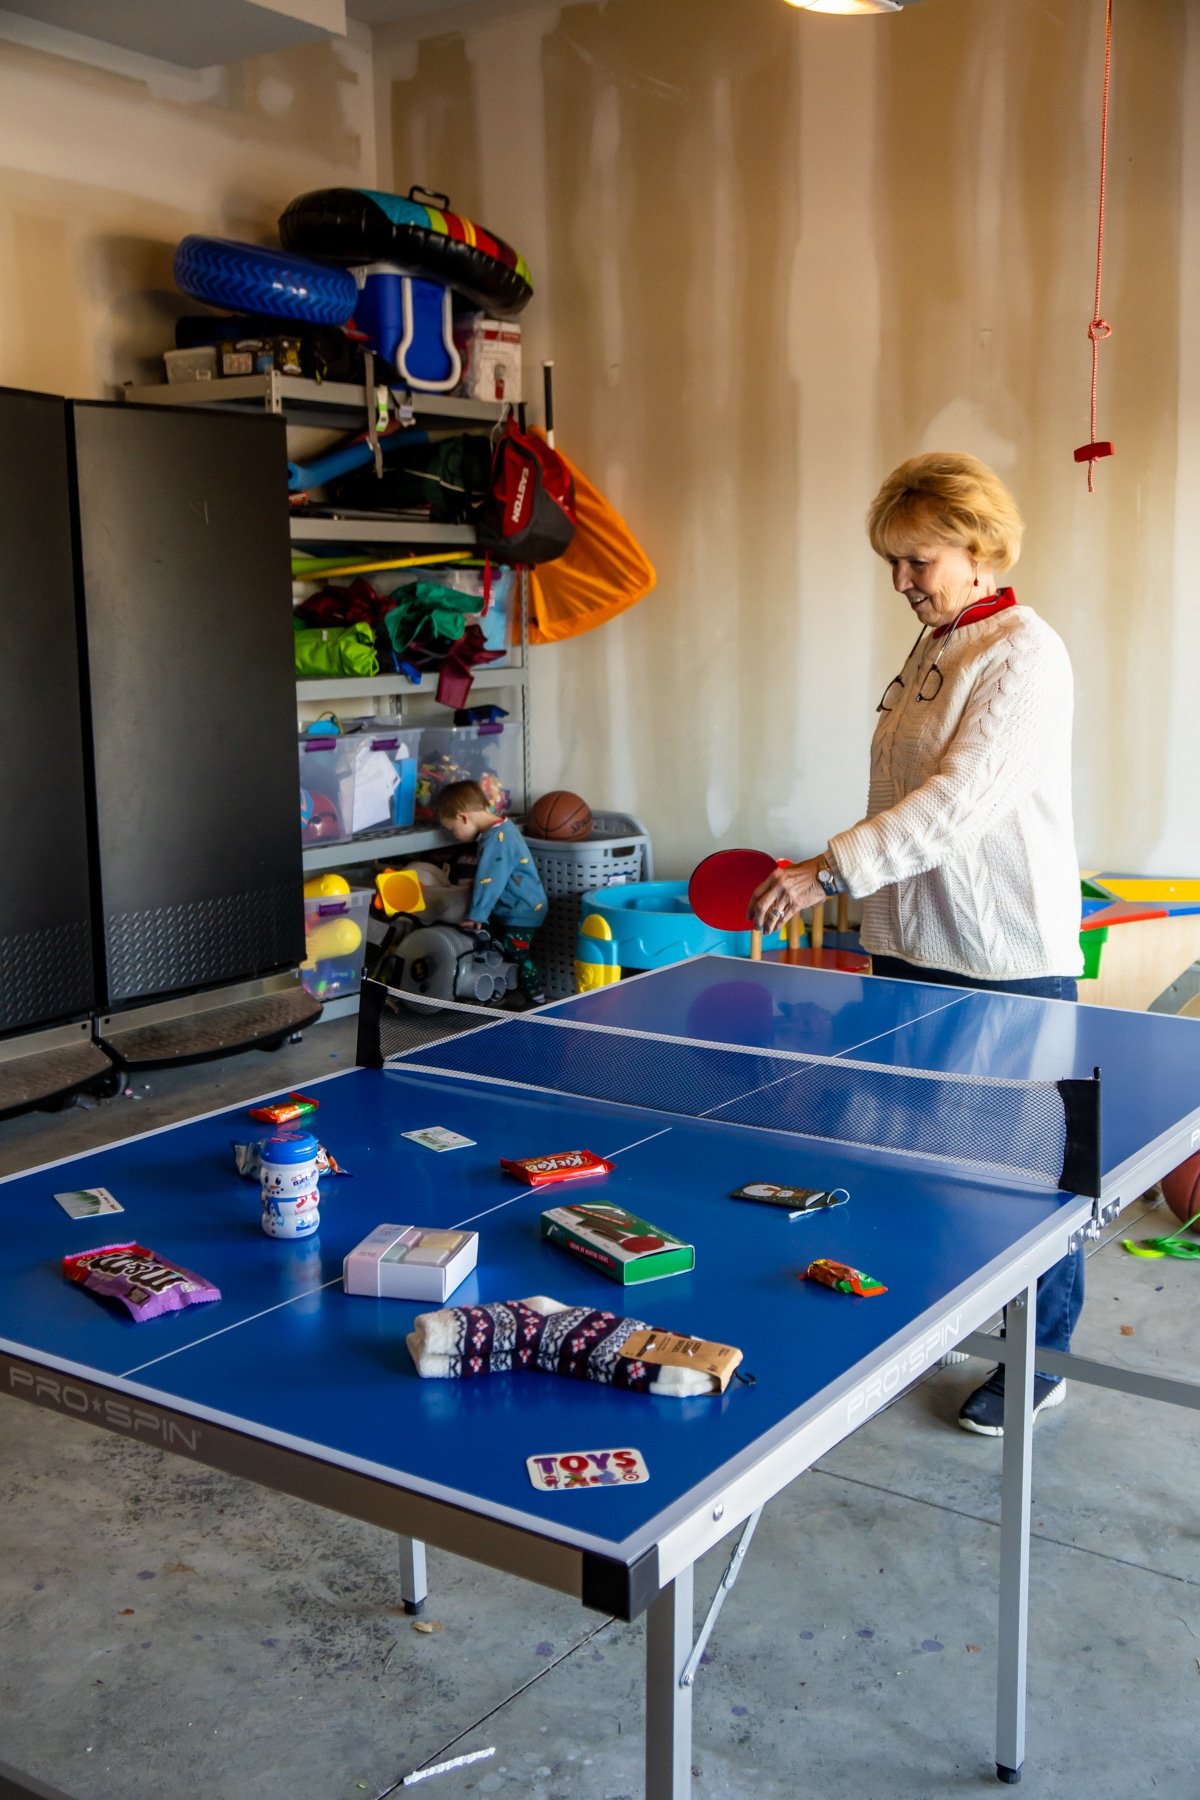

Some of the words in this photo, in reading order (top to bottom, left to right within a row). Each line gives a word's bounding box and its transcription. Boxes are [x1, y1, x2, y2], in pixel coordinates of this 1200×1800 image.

[511, 467, 529, 523] EASTON
[9, 1366, 89, 1413] PRO
[104, 1399, 198, 1451] SPIN
[533, 1451, 637, 1475] TOYS
